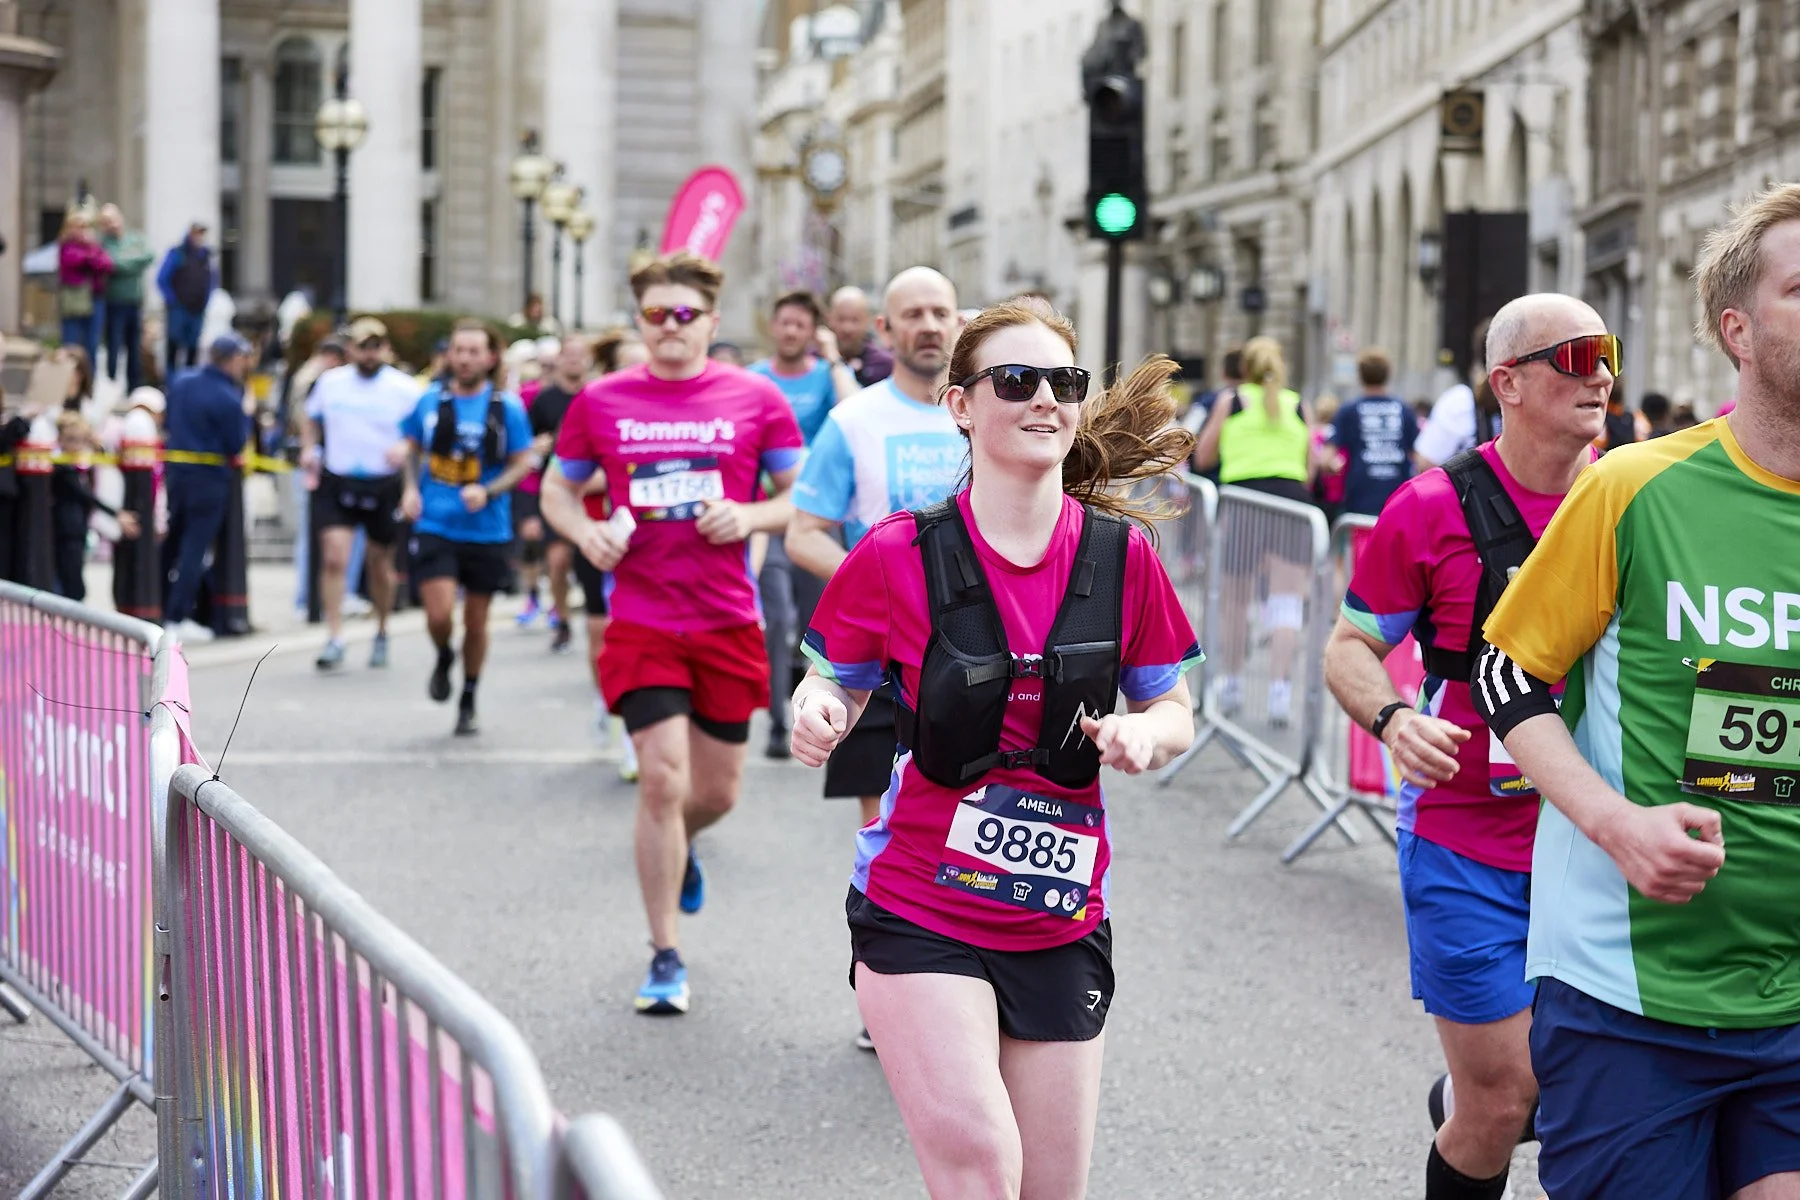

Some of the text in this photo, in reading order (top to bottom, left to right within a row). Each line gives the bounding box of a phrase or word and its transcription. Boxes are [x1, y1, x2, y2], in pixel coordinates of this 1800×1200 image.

[615, 417, 736, 444] Tommy's
[1016, 796, 1063, 818] AMELIA
[974, 817, 1079, 874] 9885
